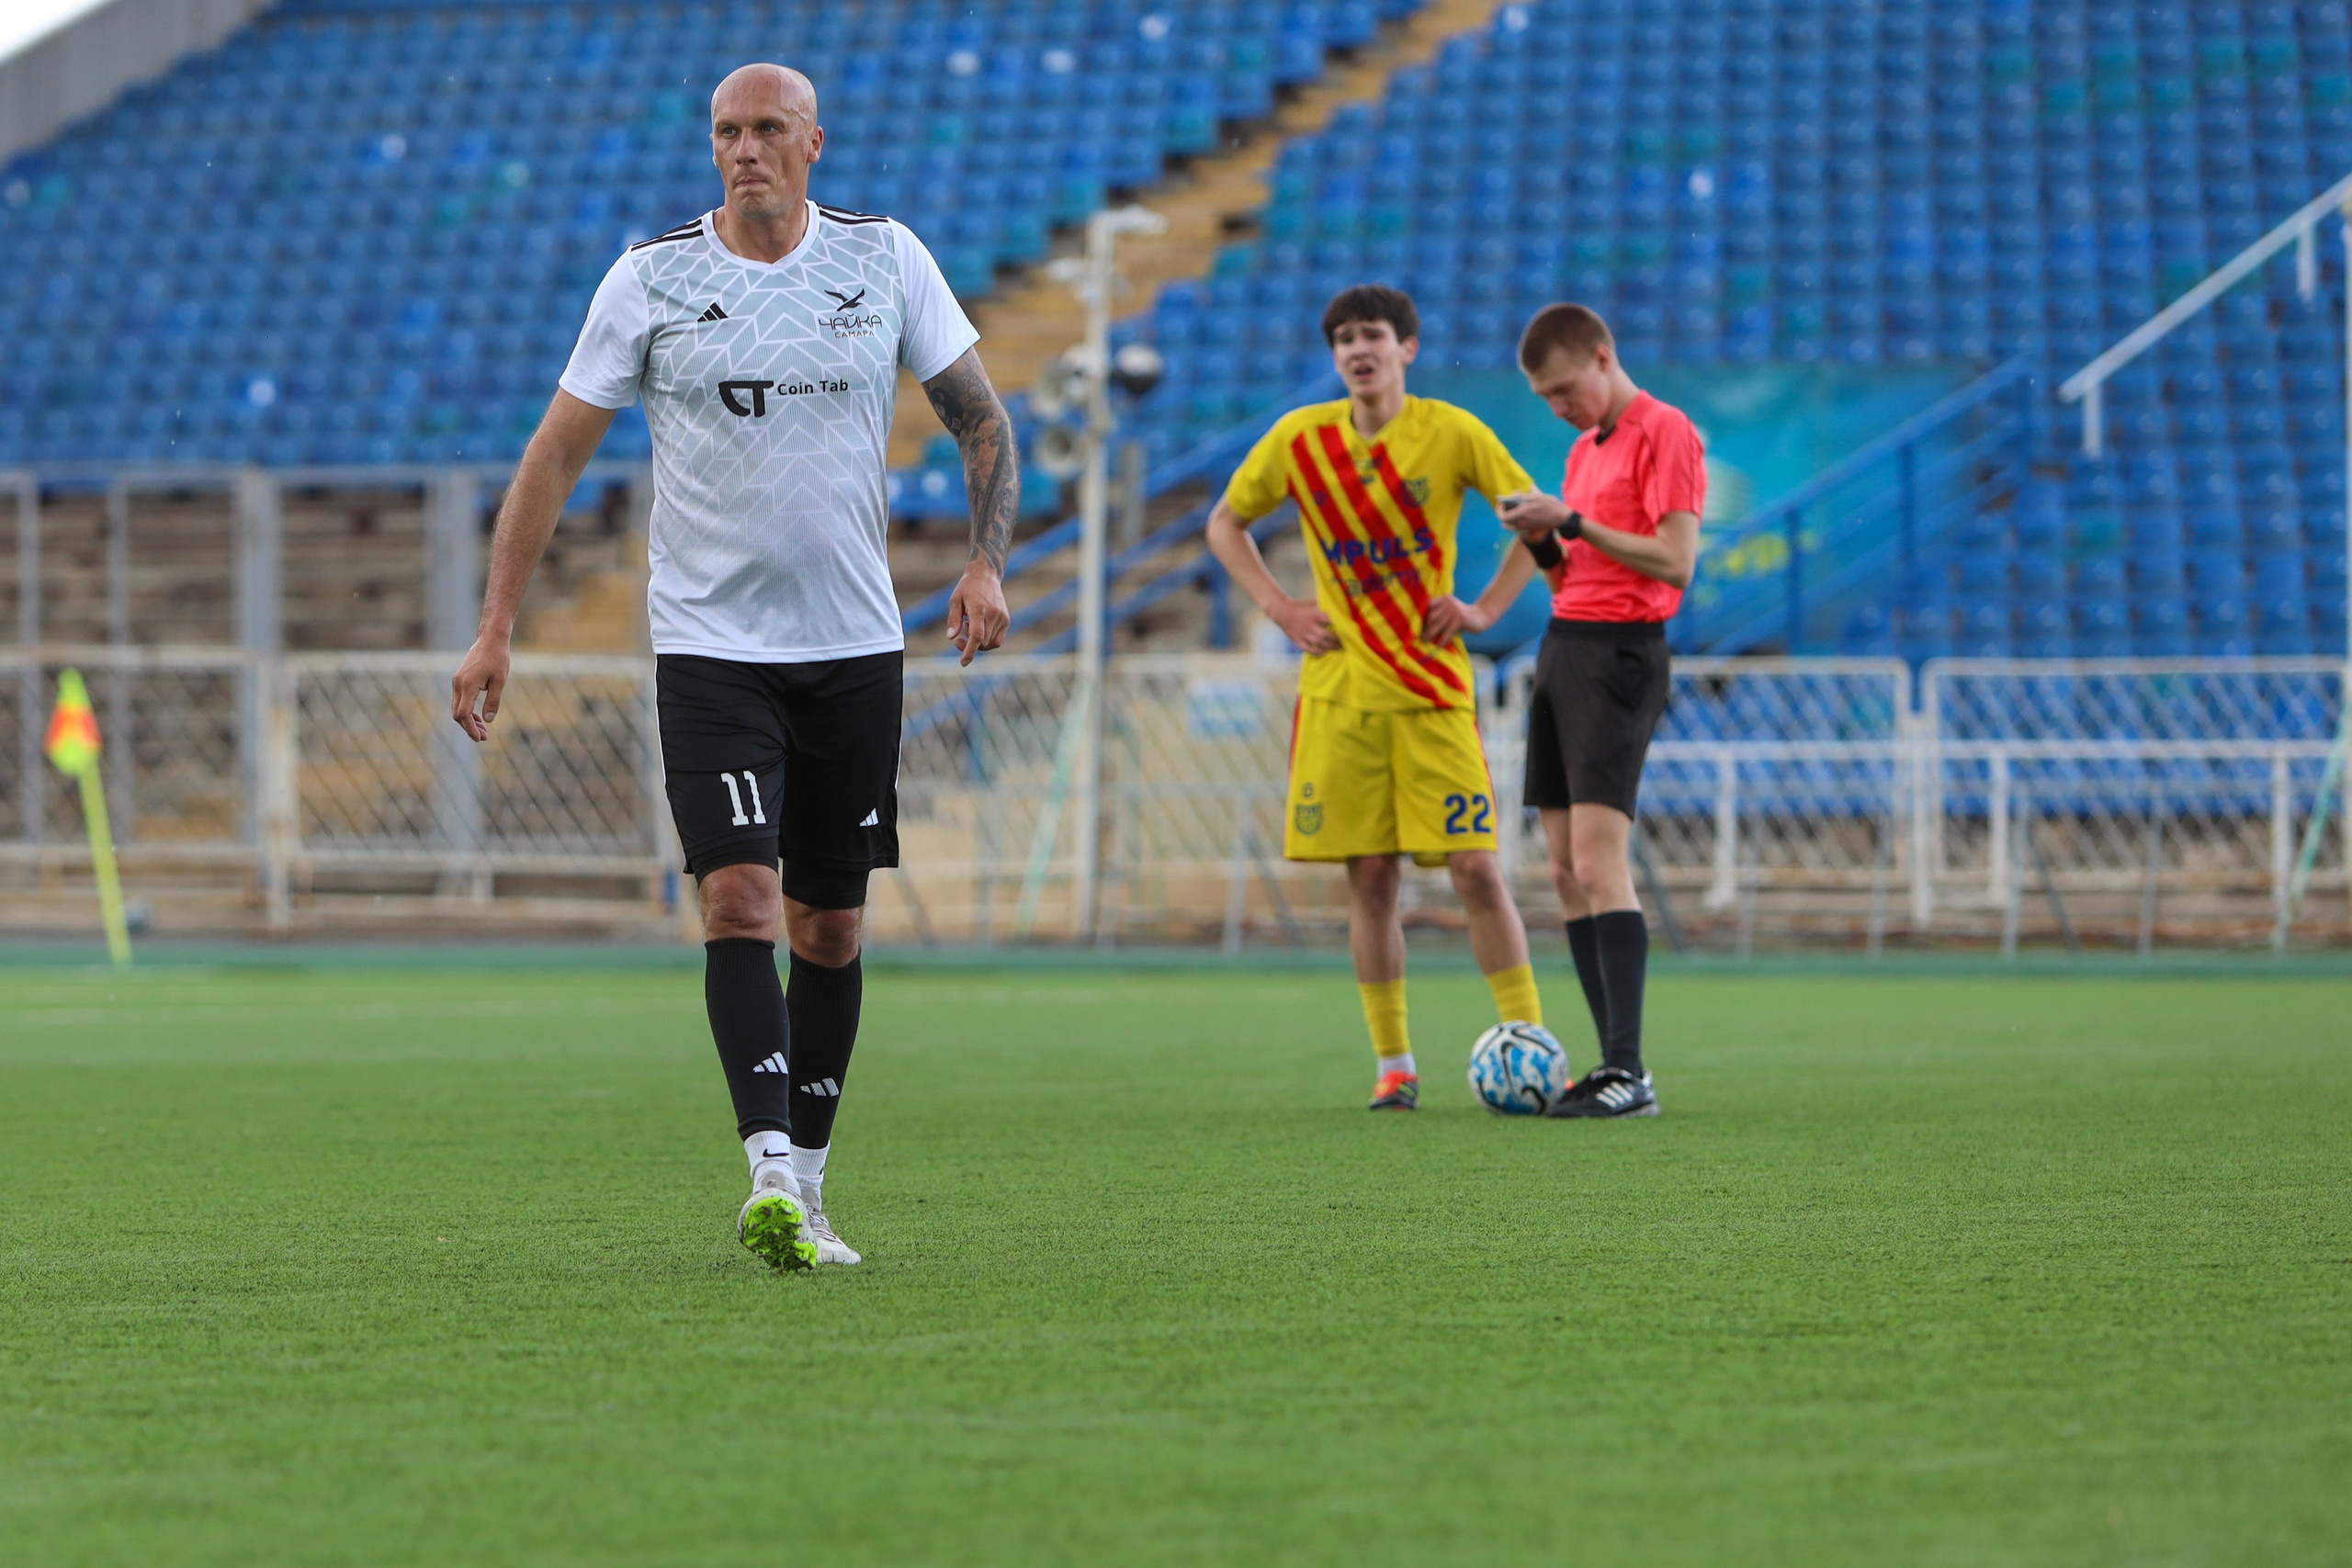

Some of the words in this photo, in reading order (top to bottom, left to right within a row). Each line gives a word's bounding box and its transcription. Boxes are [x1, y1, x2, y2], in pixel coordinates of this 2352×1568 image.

[819, 313, 882, 330] ЧАЙКА
[777, 382, 814, 395] Coin
[820, 379, 848, 392] Tab
[1320, 526, 1431, 566] MPULS
[721, 771, 766, 826] 11
[1444, 795, 1491, 834] 22
